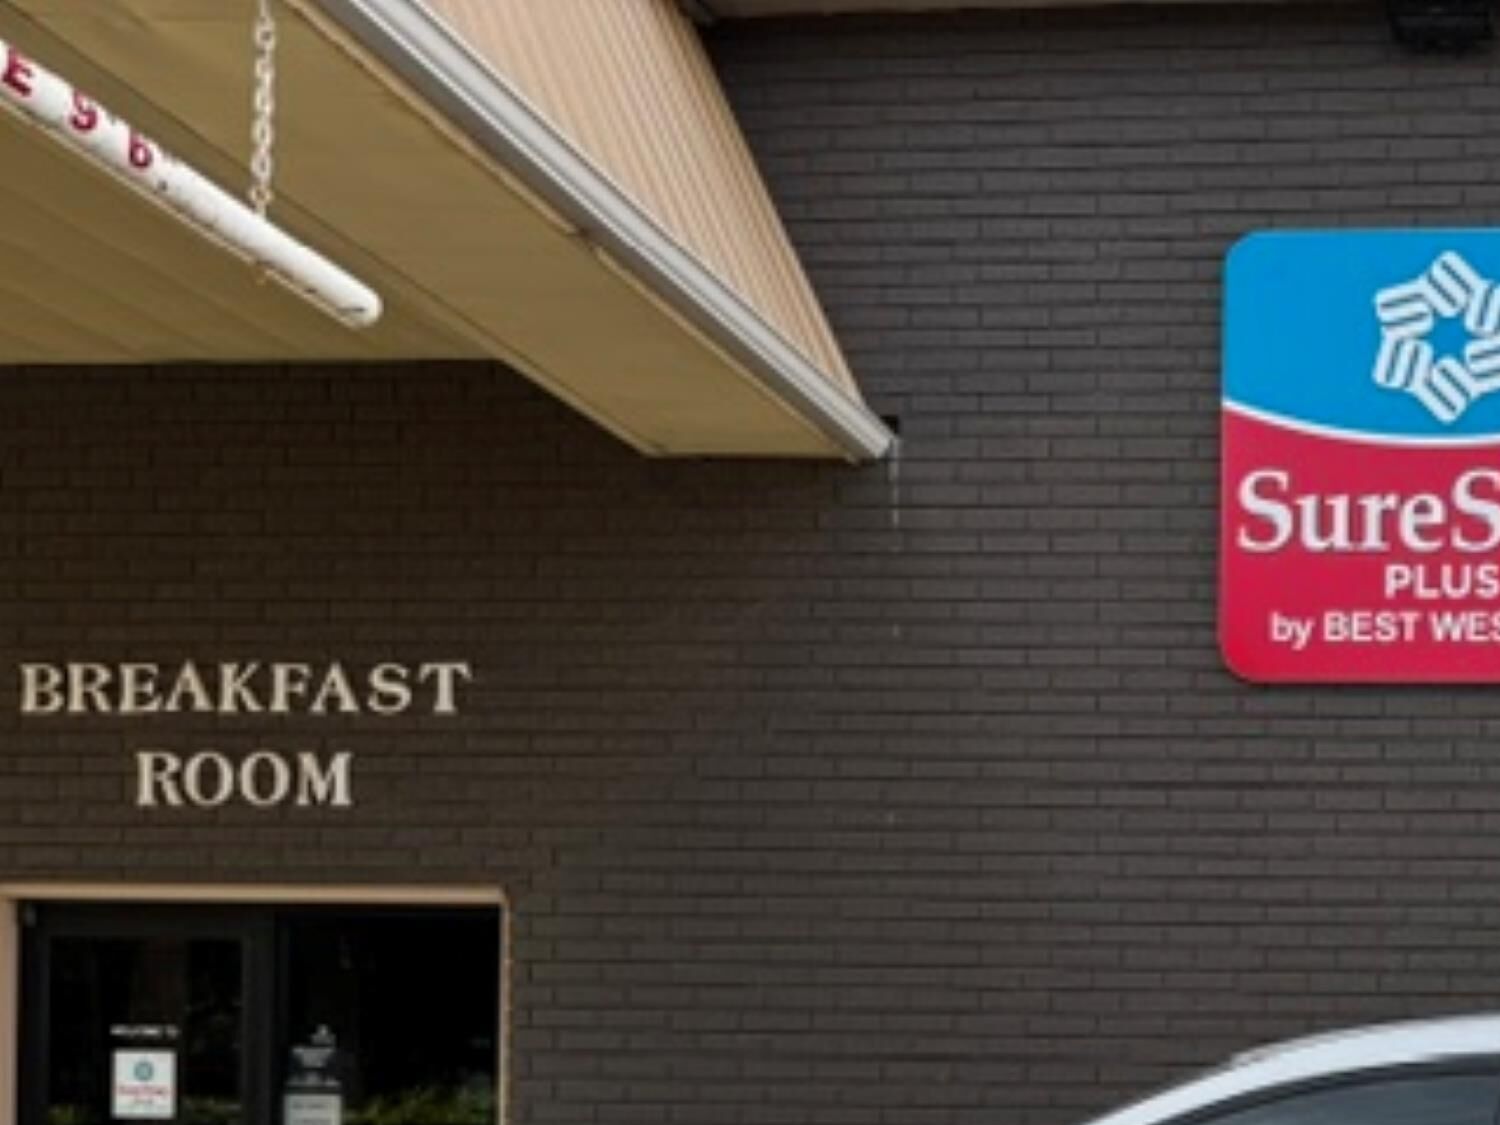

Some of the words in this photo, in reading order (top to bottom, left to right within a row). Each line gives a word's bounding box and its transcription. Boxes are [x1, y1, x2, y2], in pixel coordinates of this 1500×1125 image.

[1269, 610, 1313, 651] by
[1323, 610, 1420, 643] BEST
[19, 658, 474, 714] BREAKFAST
[135, 750, 354, 807] ROOM
